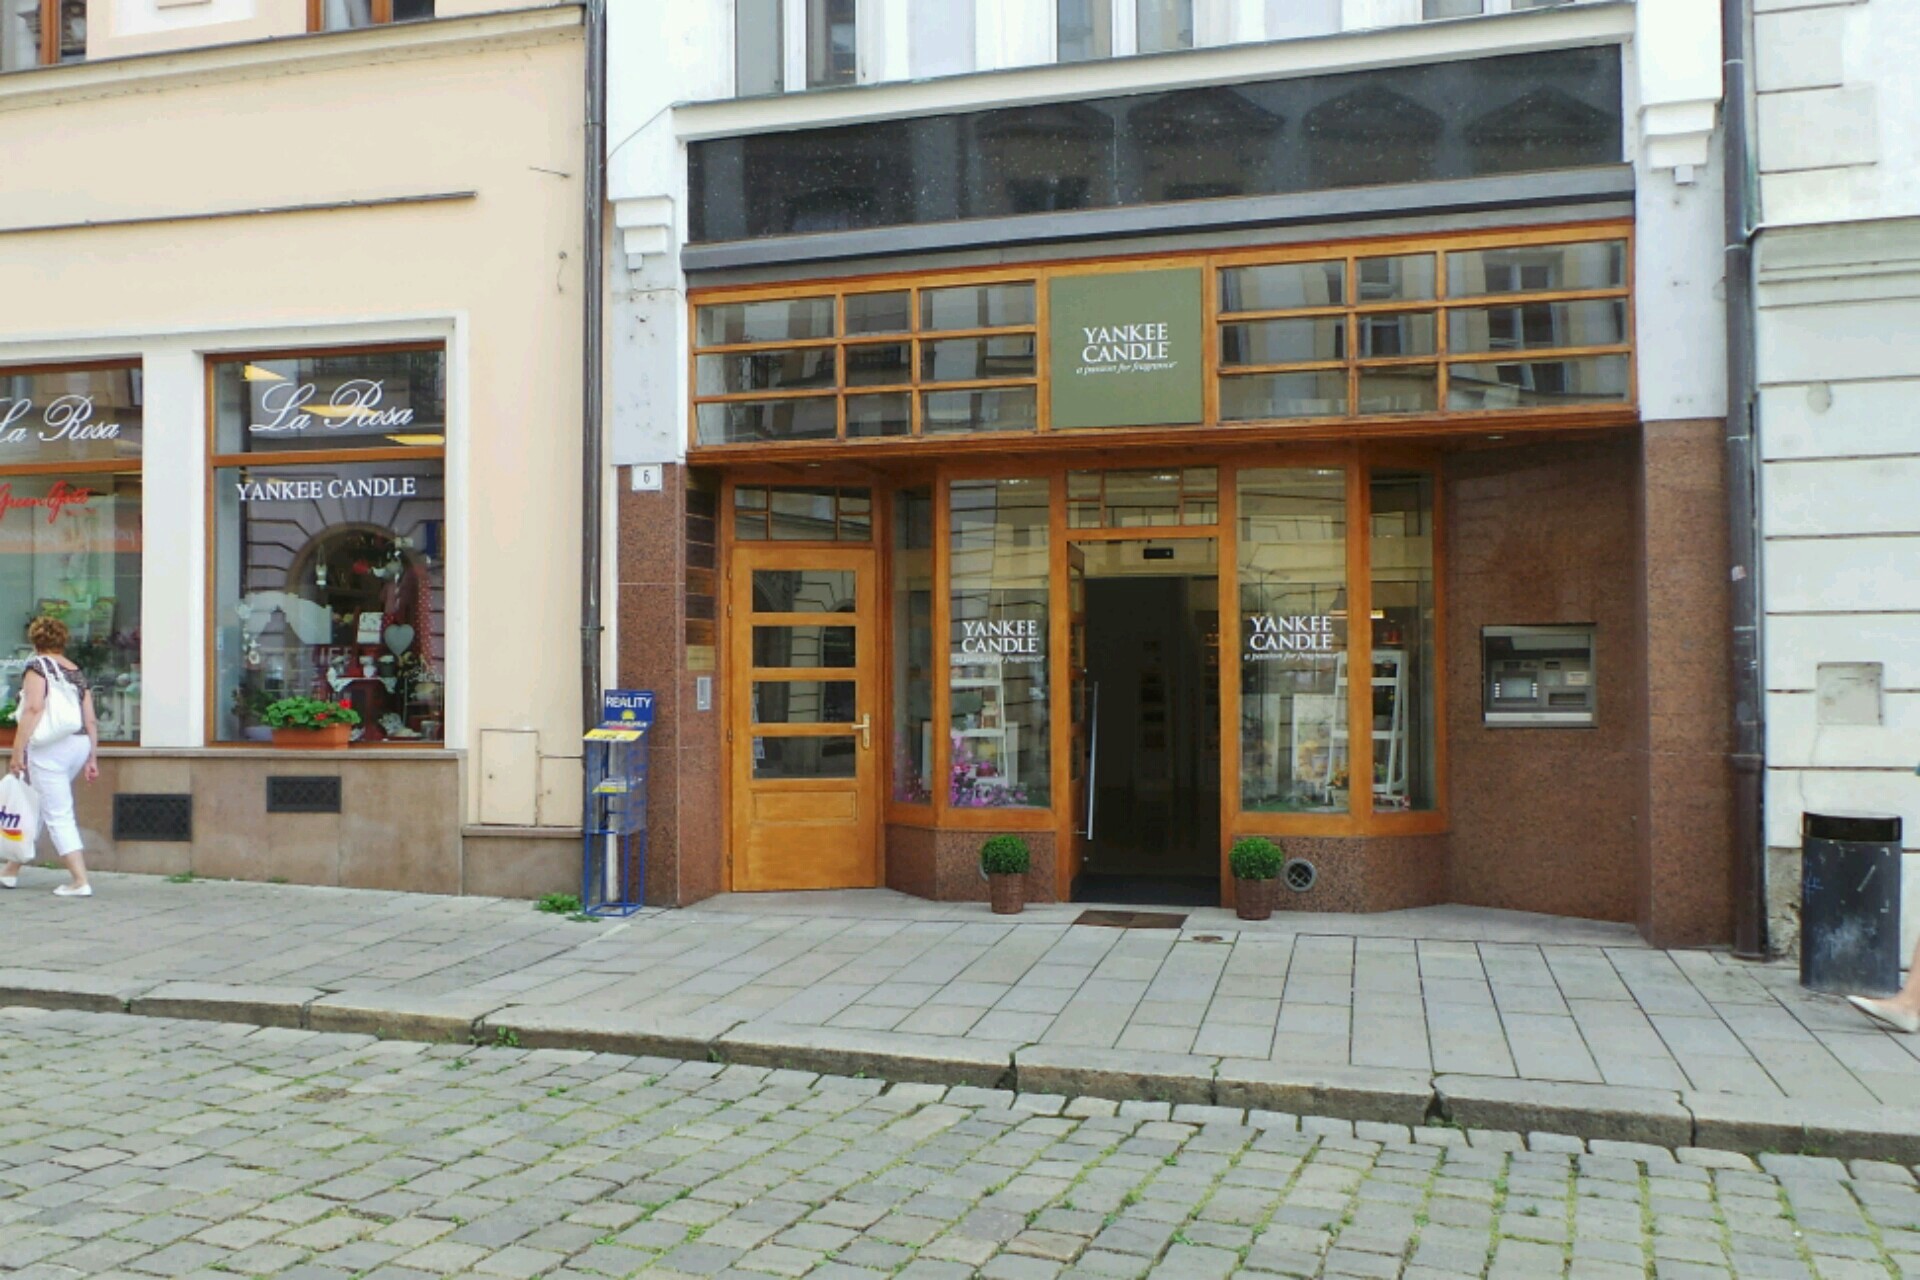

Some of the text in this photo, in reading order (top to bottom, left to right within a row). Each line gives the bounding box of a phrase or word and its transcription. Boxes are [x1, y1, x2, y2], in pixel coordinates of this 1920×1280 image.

[1082, 322, 1168, 344] YANKEE
[1082, 341, 1172, 362] CANDLE
[249, 379, 413, 431] La Rosa
[38, 394, 120, 441] Rosa
[643, 469, 651, 485] 6
[236, 477, 416, 500] YANKEE CANDLE
[962, 619, 1038, 637] YANKEE
[1250, 615, 1333, 633] YANKEE
[961, 637, 1040, 653] CANDLE
[1249, 633, 1334, 651] CANDLE
[605, 696, 652, 709] REALITY
